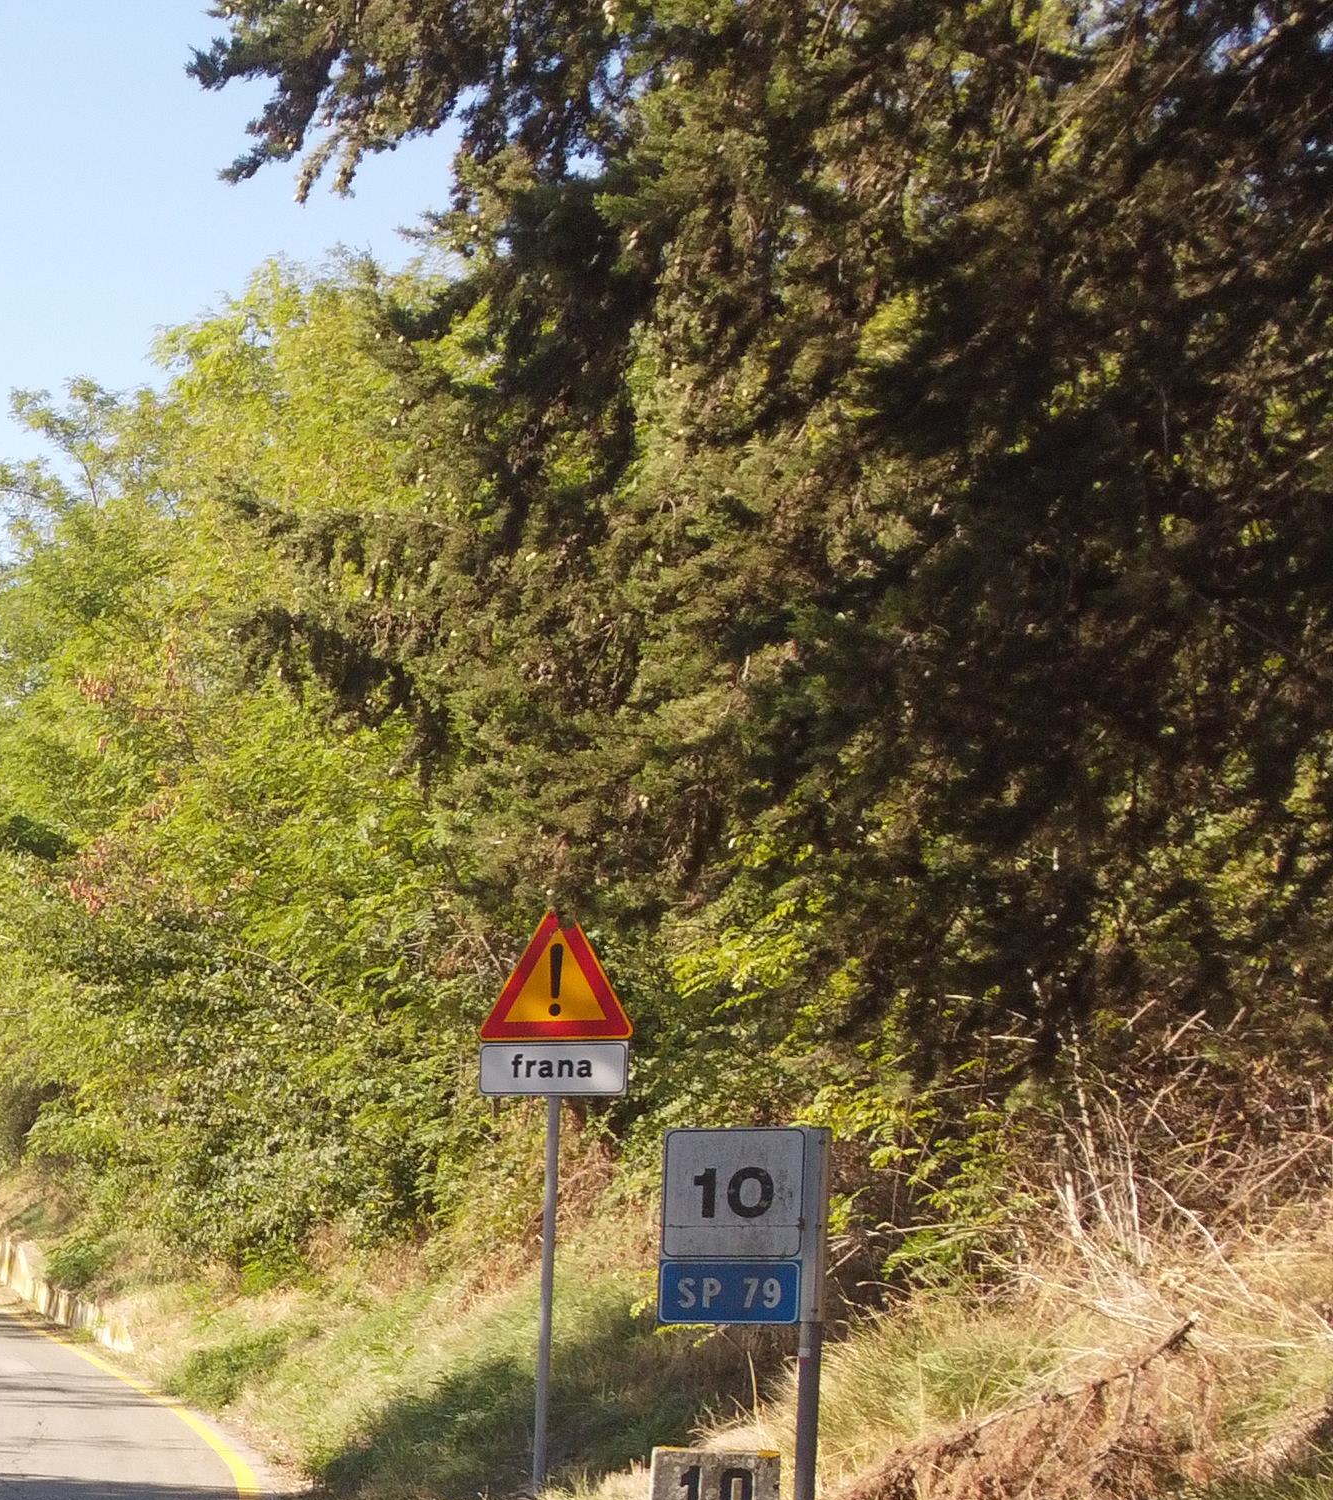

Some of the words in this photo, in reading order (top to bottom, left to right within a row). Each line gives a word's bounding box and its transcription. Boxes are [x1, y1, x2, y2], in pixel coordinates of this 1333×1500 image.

[511, 1054, 593, 1079] frana
[694, 1167, 775, 1219] 10
[677, 1277, 722, 1309] SP
[743, 1277, 782, 1309] 79
